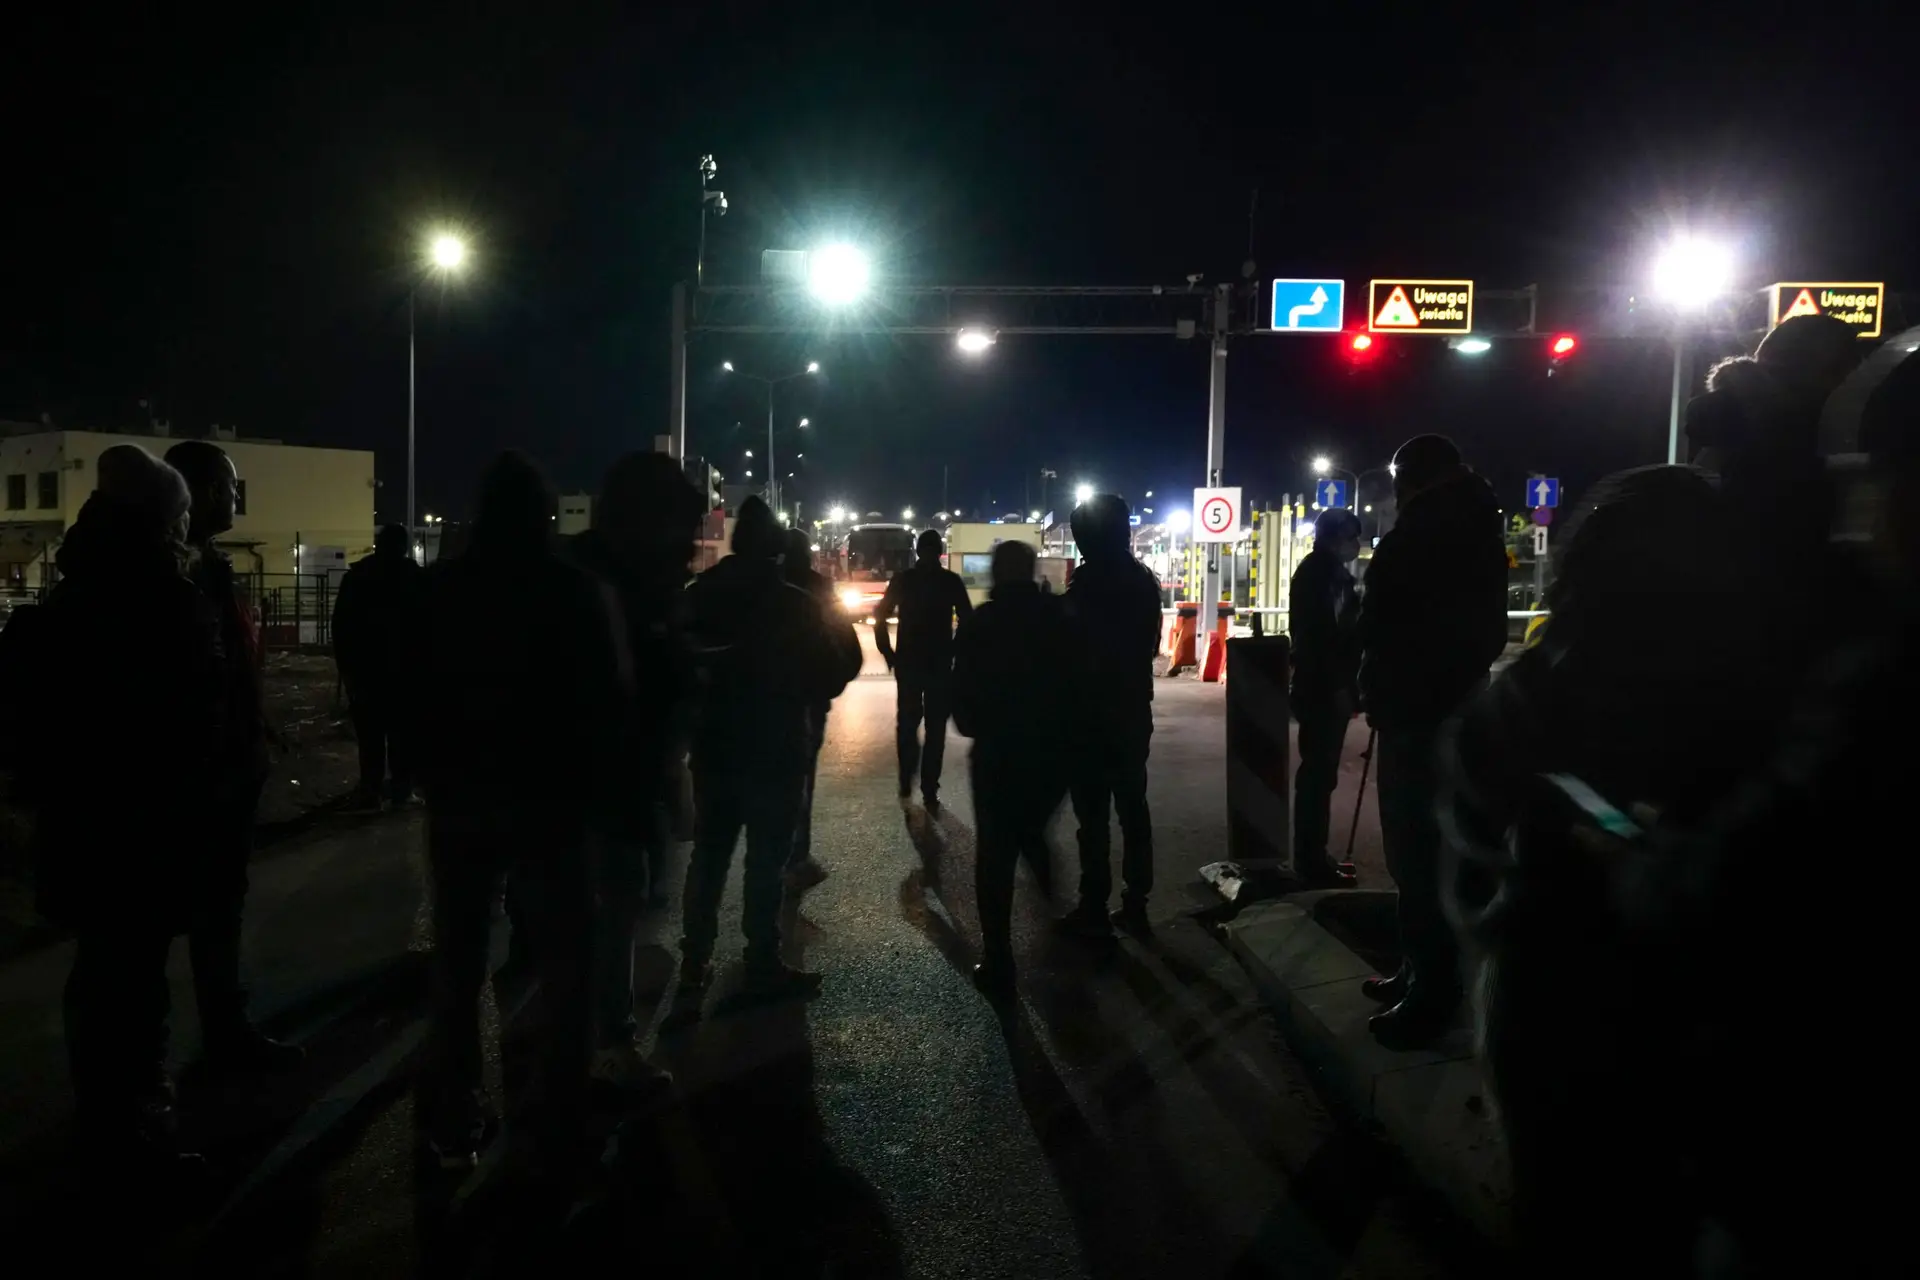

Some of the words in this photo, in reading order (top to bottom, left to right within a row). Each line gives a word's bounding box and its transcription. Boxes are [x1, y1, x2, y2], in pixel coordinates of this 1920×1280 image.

[1414, 287, 1467, 308] Uwaga
[1821, 290, 1877, 311] Uwaga
[1212, 508, 1221, 524] 5
